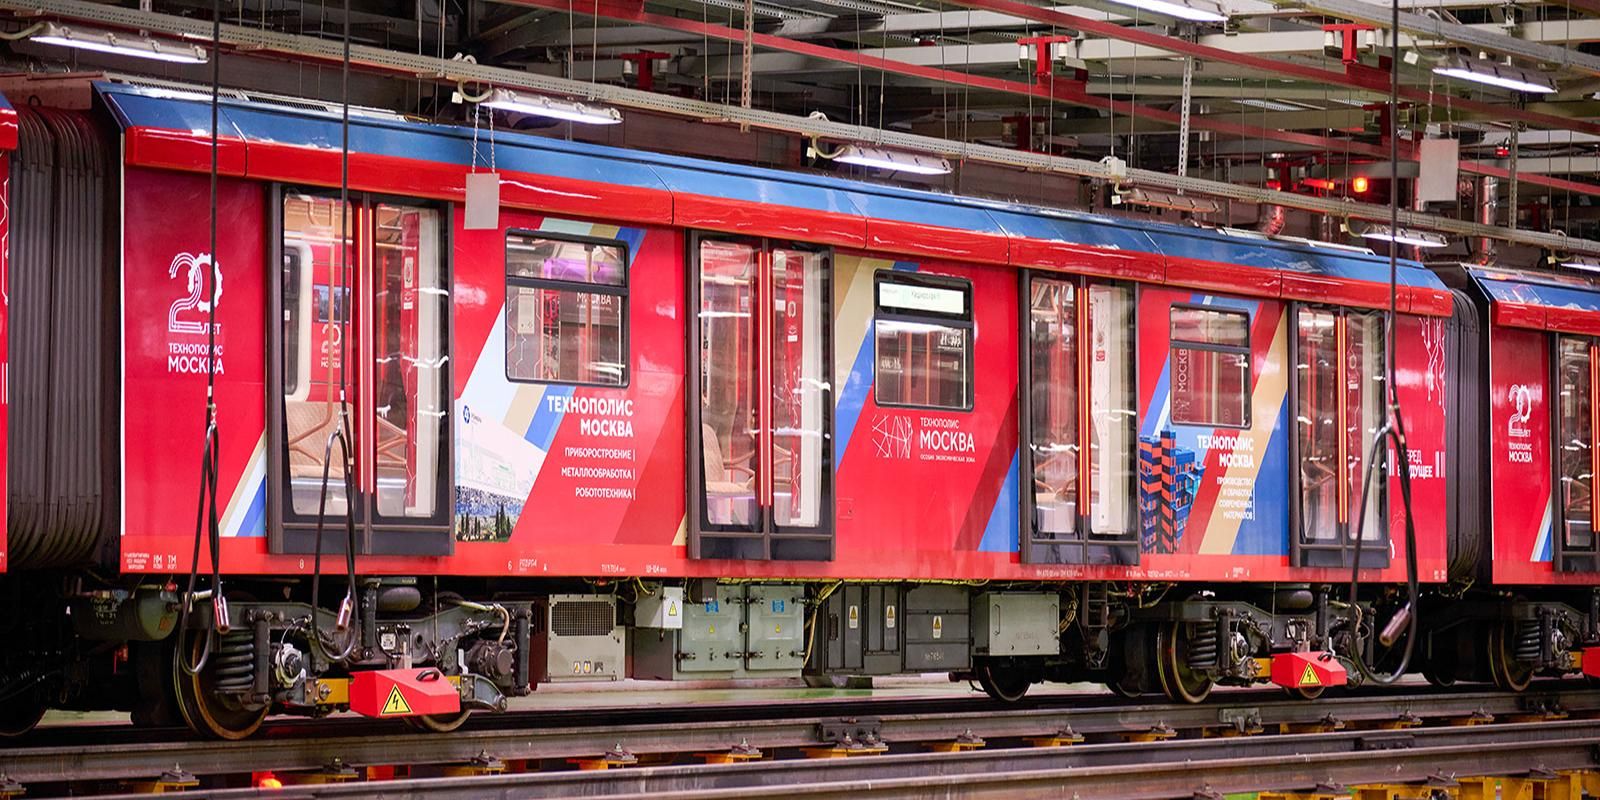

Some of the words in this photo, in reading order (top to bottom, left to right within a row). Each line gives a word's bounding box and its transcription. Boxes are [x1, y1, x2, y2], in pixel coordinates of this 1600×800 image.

[1178, 348, 1187, 393] МОСКВ
[547, 395, 633, 416] ТЕХНОПОЛИС
[580, 418, 634, 437] МОСКВА
[920, 417, 960, 429] ТЕХНОПОЛИС
[920, 430, 975, 452] МОСКВА
[1197, 434, 1255, 451] ТЕХНОПОЛИС
[564, 446, 632, 460] ПРИБОРОСТРОЕНИЕ
[1218, 453, 1255, 468] МОСКВА
[1508, 451, 1533, 463] МОСКВА
[561, 466, 633, 480] МЕТАЛЛООБРАБОТКА
[575, 487, 633, 500] РОБОТОТЕХНИКА
